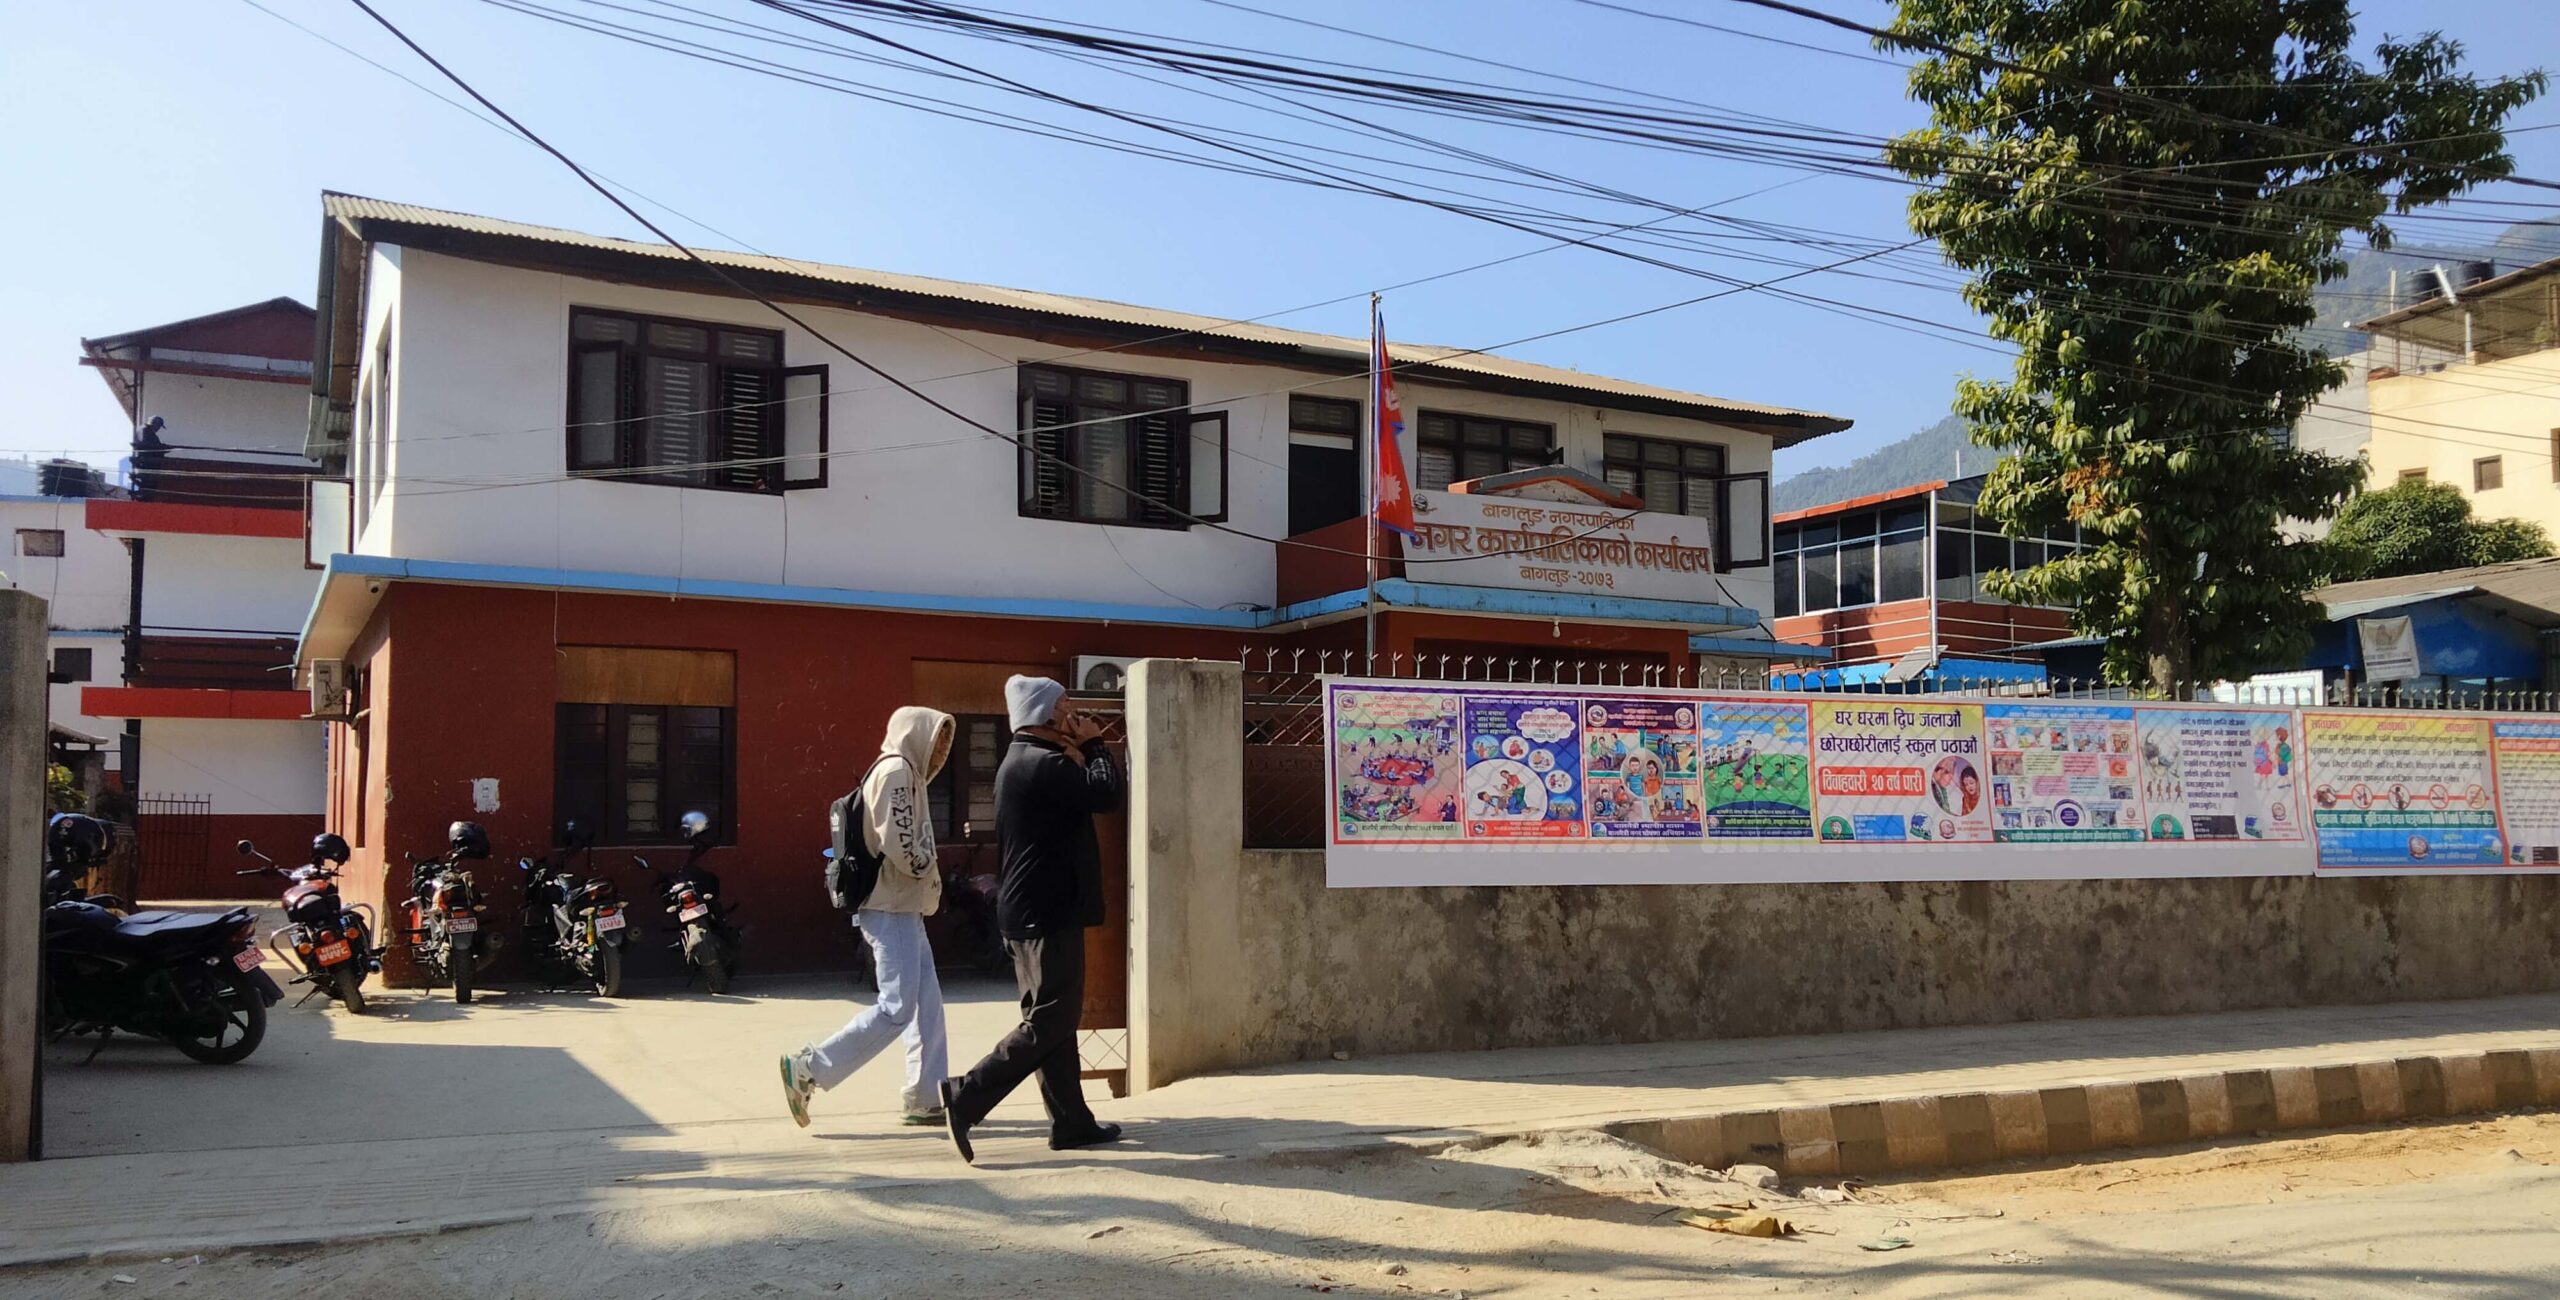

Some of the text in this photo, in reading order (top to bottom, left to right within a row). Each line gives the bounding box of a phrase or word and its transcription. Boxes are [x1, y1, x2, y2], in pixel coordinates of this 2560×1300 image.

[1481, 502, 1635, 531] बागलुङ नगरपालिका
[1412, 522, 1713, 574] नगर कार्यपालिकाको कार्यालय
[1835, 711, 1854, 727] घर
[1857, 711, 1889, 727] घरमा
